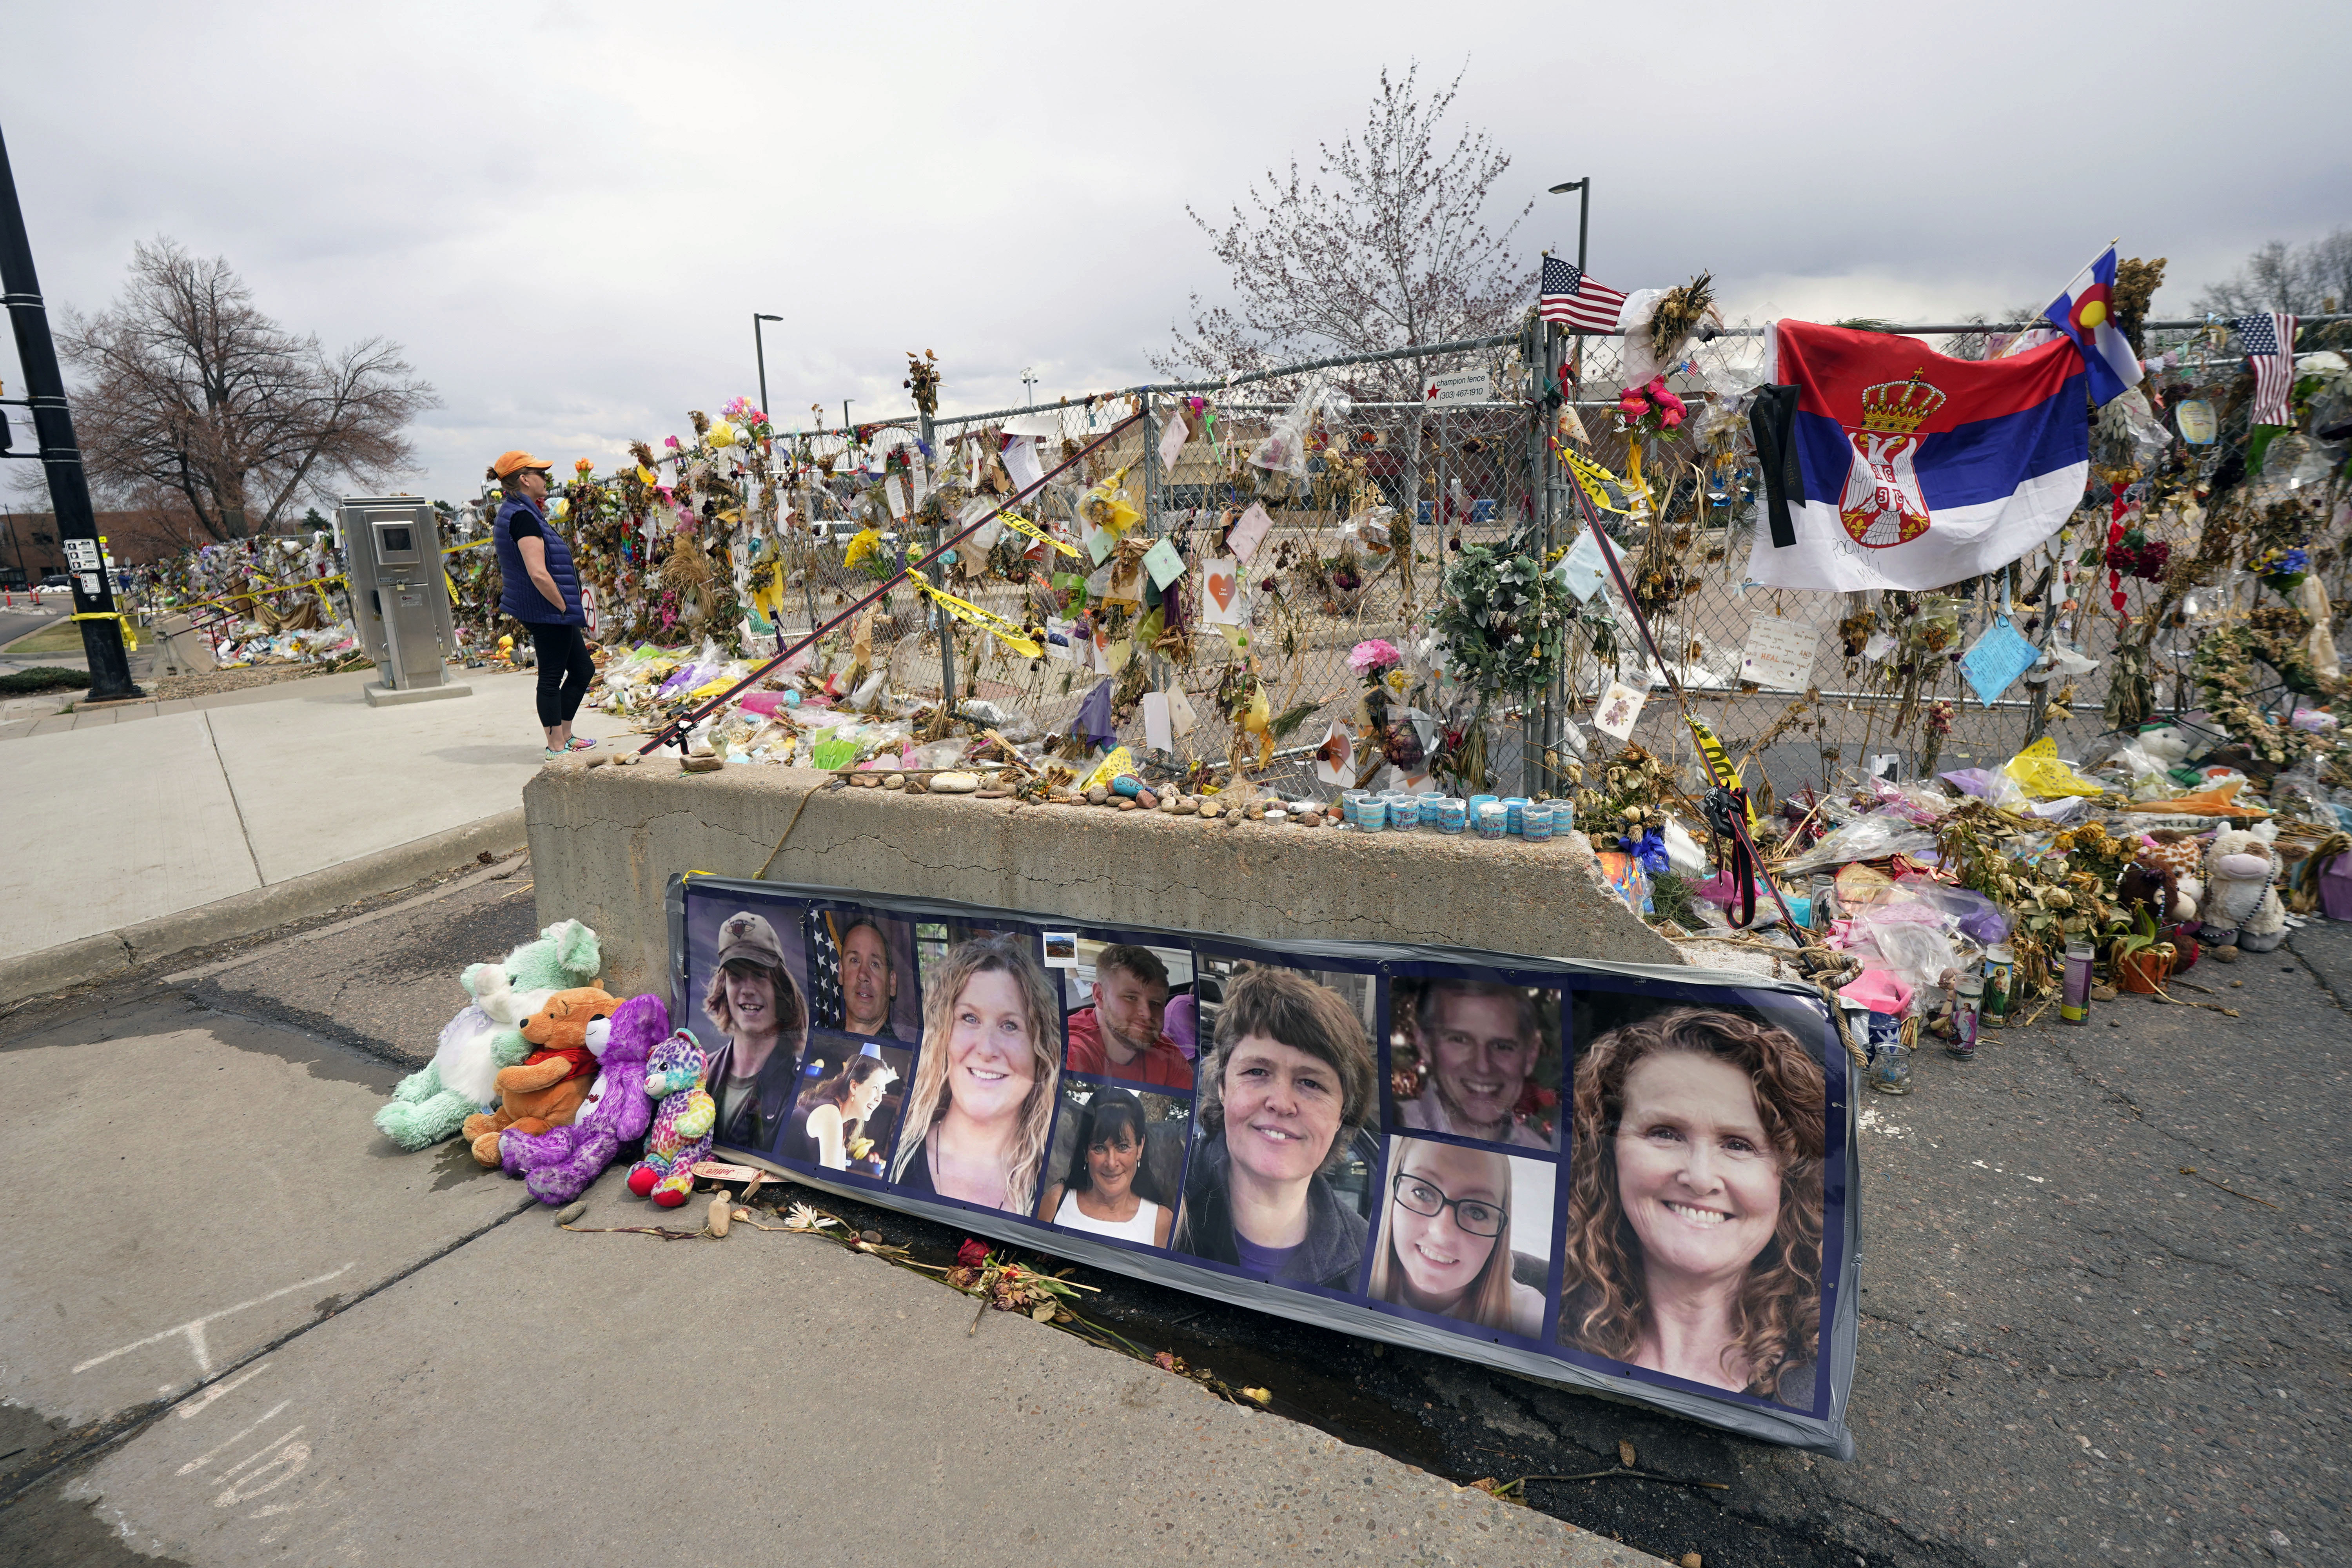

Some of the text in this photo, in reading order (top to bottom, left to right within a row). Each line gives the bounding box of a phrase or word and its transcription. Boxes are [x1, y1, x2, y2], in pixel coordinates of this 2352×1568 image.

[1436, 377, 1465, 387] champion
[1439, 387, 1483, 401] (303) 467-1910
[1860, 554, 1870, 567] U
[1799, 650, 1812, 658] AND
[1761, 653, 1780, 662] HEAL
[1794, 662, 1811, 671] you!
[1117, 778, 1141, 790] LOVE
